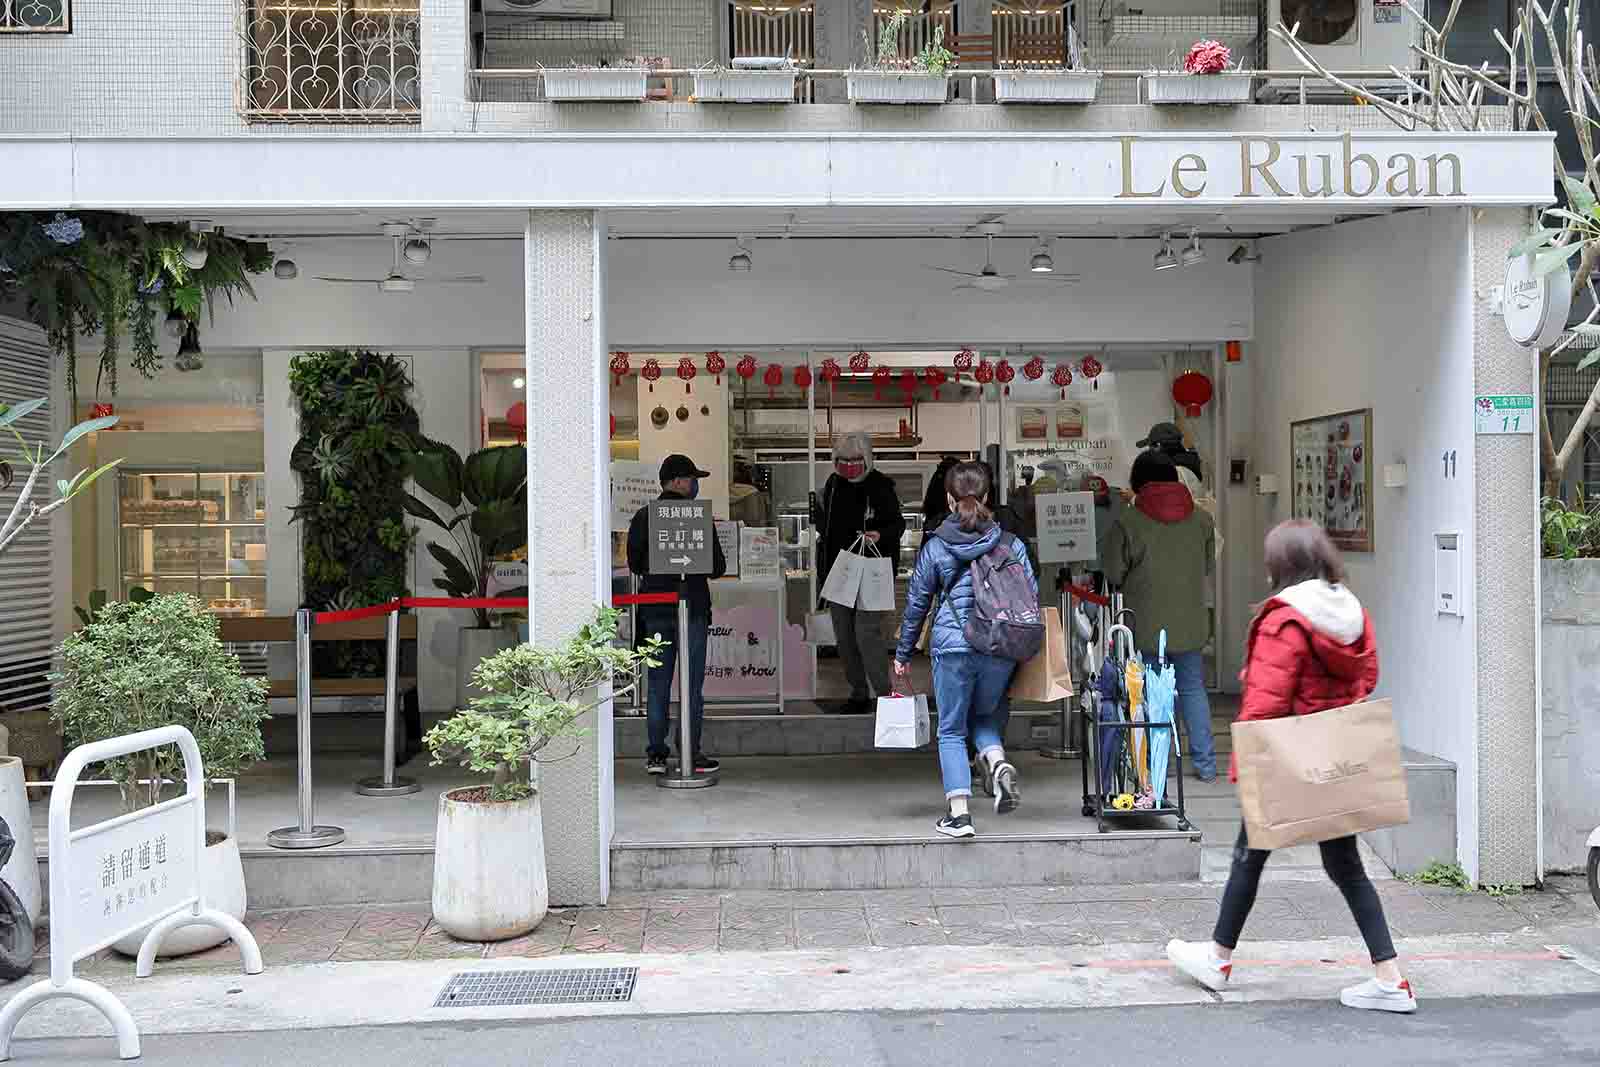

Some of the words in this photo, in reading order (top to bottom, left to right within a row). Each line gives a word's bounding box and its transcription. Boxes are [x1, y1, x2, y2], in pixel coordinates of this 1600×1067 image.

[1113, 135, 1208, 198] Le
[1233, 128, 1468, 198] Ruban
[1502, 416, 1520, 432] 11
[1442, 450, 1457, 479] 11
[658, 506, 704, 518] 現貨購買
[747, 631, 759, 646] &
[741, 663, 776, 677] show
[102, 834, 168, 888] 請留通道
